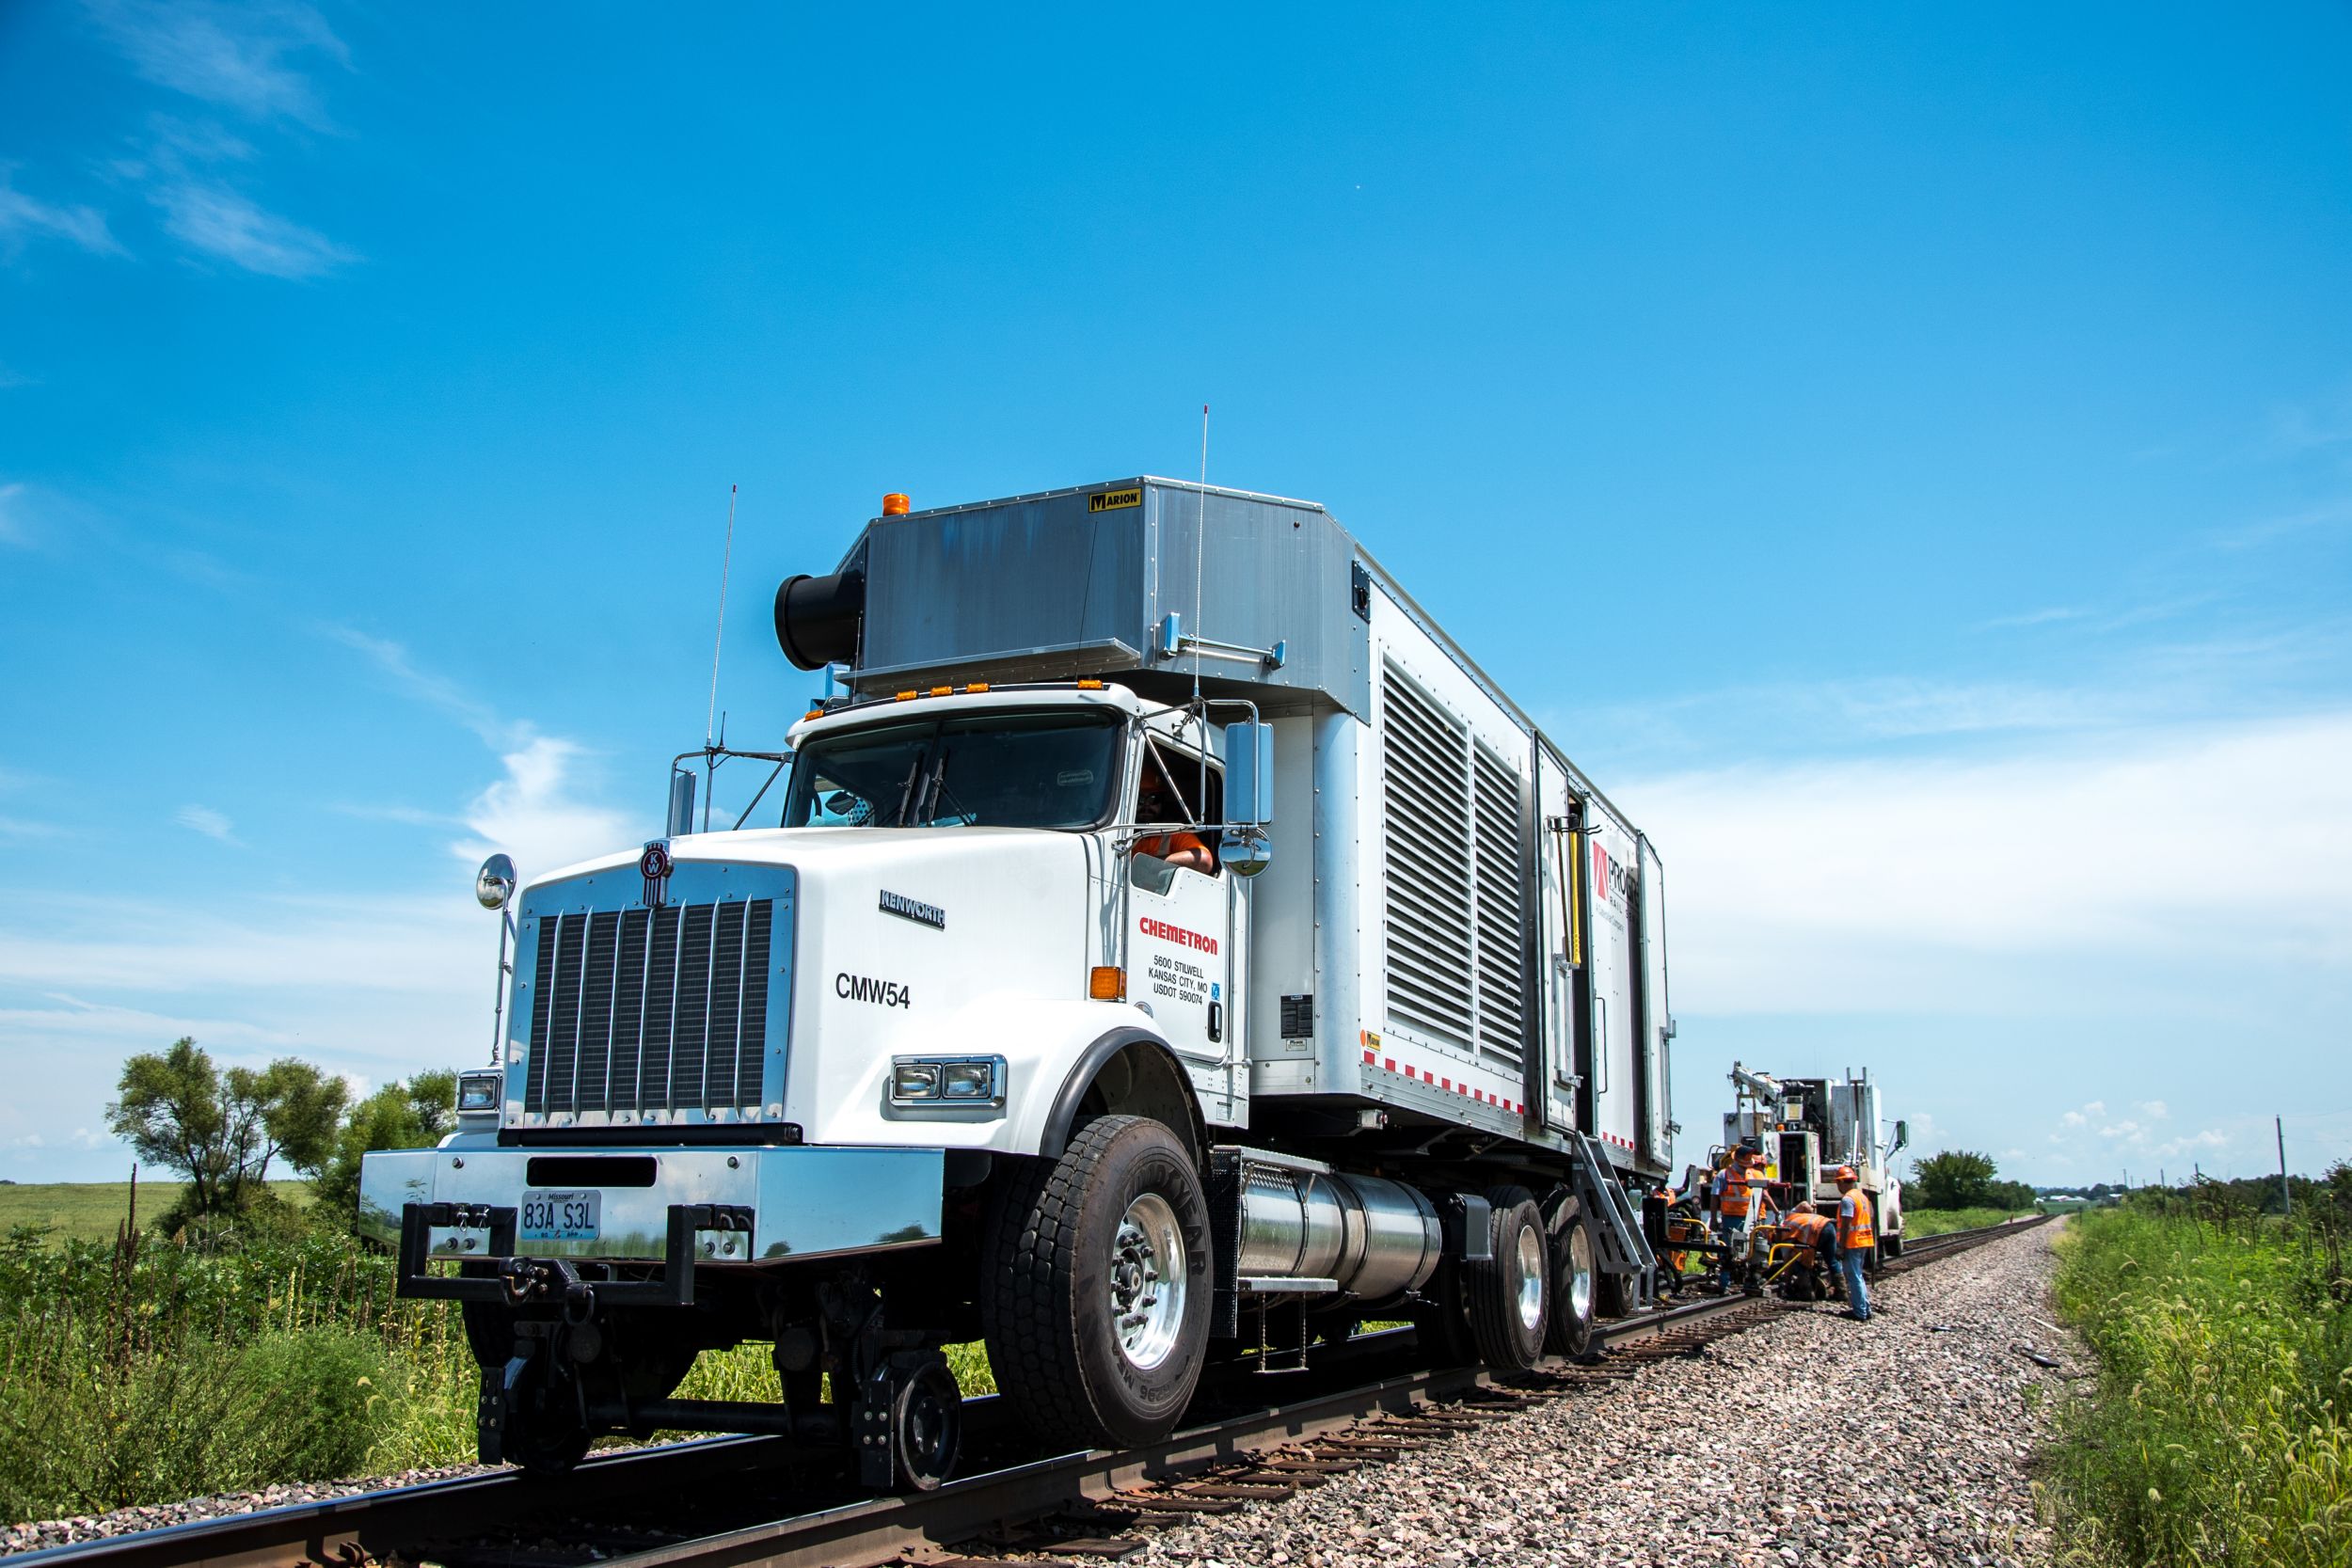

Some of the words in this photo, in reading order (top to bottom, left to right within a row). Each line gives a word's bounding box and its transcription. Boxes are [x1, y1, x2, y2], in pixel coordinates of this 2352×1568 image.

[1090, 493, 1137, 511] MARION
[880, 889, 946, 925] KENWORTH
[1139, 917, 1218, 956] CHEMETRON
[1148, 967, 1177, 985] KANSAS
[1179, 975, 1196, 992] CITY,
[1197, 981, 1208, 993] MO
[1153, 955, 1172, 969] 5600
[1174, 960, 1204, 979] STILWELL
[835, 973, 911, 1009] CMW54
[1153, 982, 1177, 998] USDOT
[1179, 990, 1203, 1006] 590074
[524, 1202, 554, 1229] 83A
[564, 1202, 595, 1229] S3L
